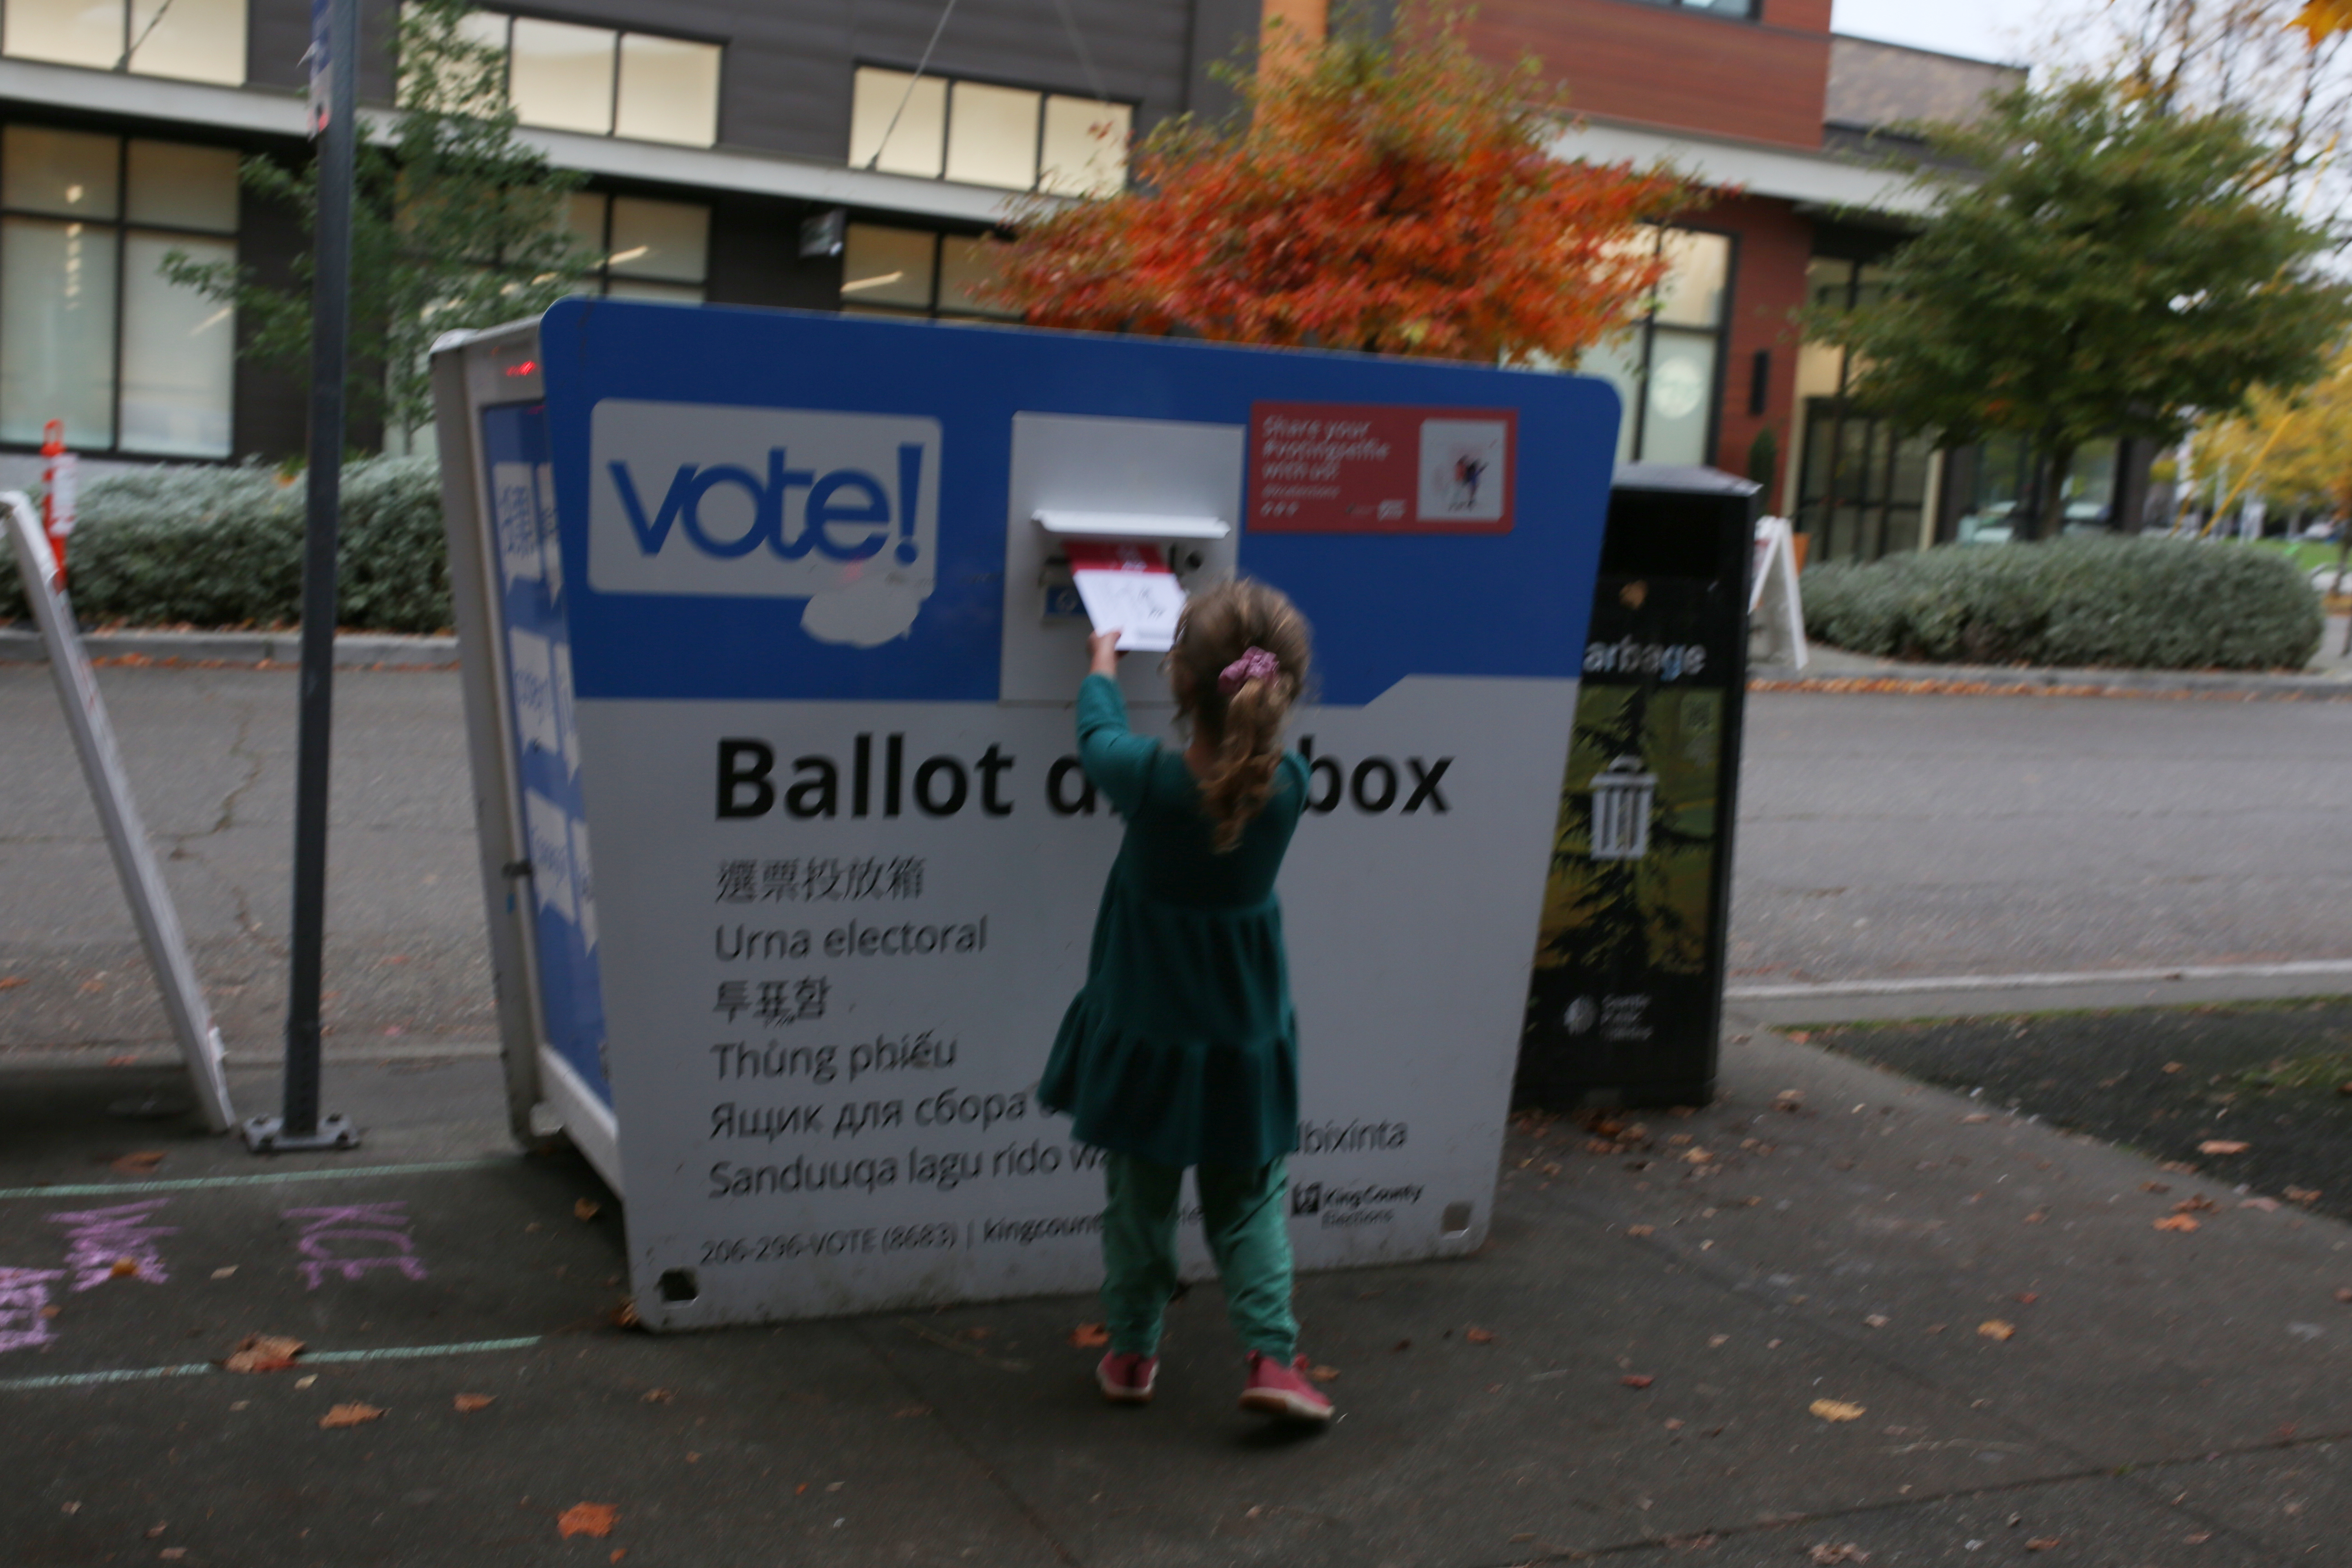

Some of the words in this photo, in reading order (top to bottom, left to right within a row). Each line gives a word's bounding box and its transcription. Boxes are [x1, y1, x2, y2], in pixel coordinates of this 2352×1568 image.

[1582, 633, 1707, 682] arbage
[716, 732, 1015, 818] Ballot
[1298, 734, 1456, 817] box
[715, 924, 812, 962] Urna
[824, 915, 988, 958] electoral
[712, 976, 832, 1026] 투표함
[710, 1039, 840, 1085] Thùng
[709, 1102, 824, 1143] Ящик
[832, 1100, 904, 1139] для
[914, 1087, 1027, 1133] сбора
[709, 1154, 899, 1198] Sanduuqa
[909, 1146, 983, 1192] lagu
[1295, 1119, 1409, 1155] bixinta
[699, 1227, 878, 1266] 206-296-VOTE
